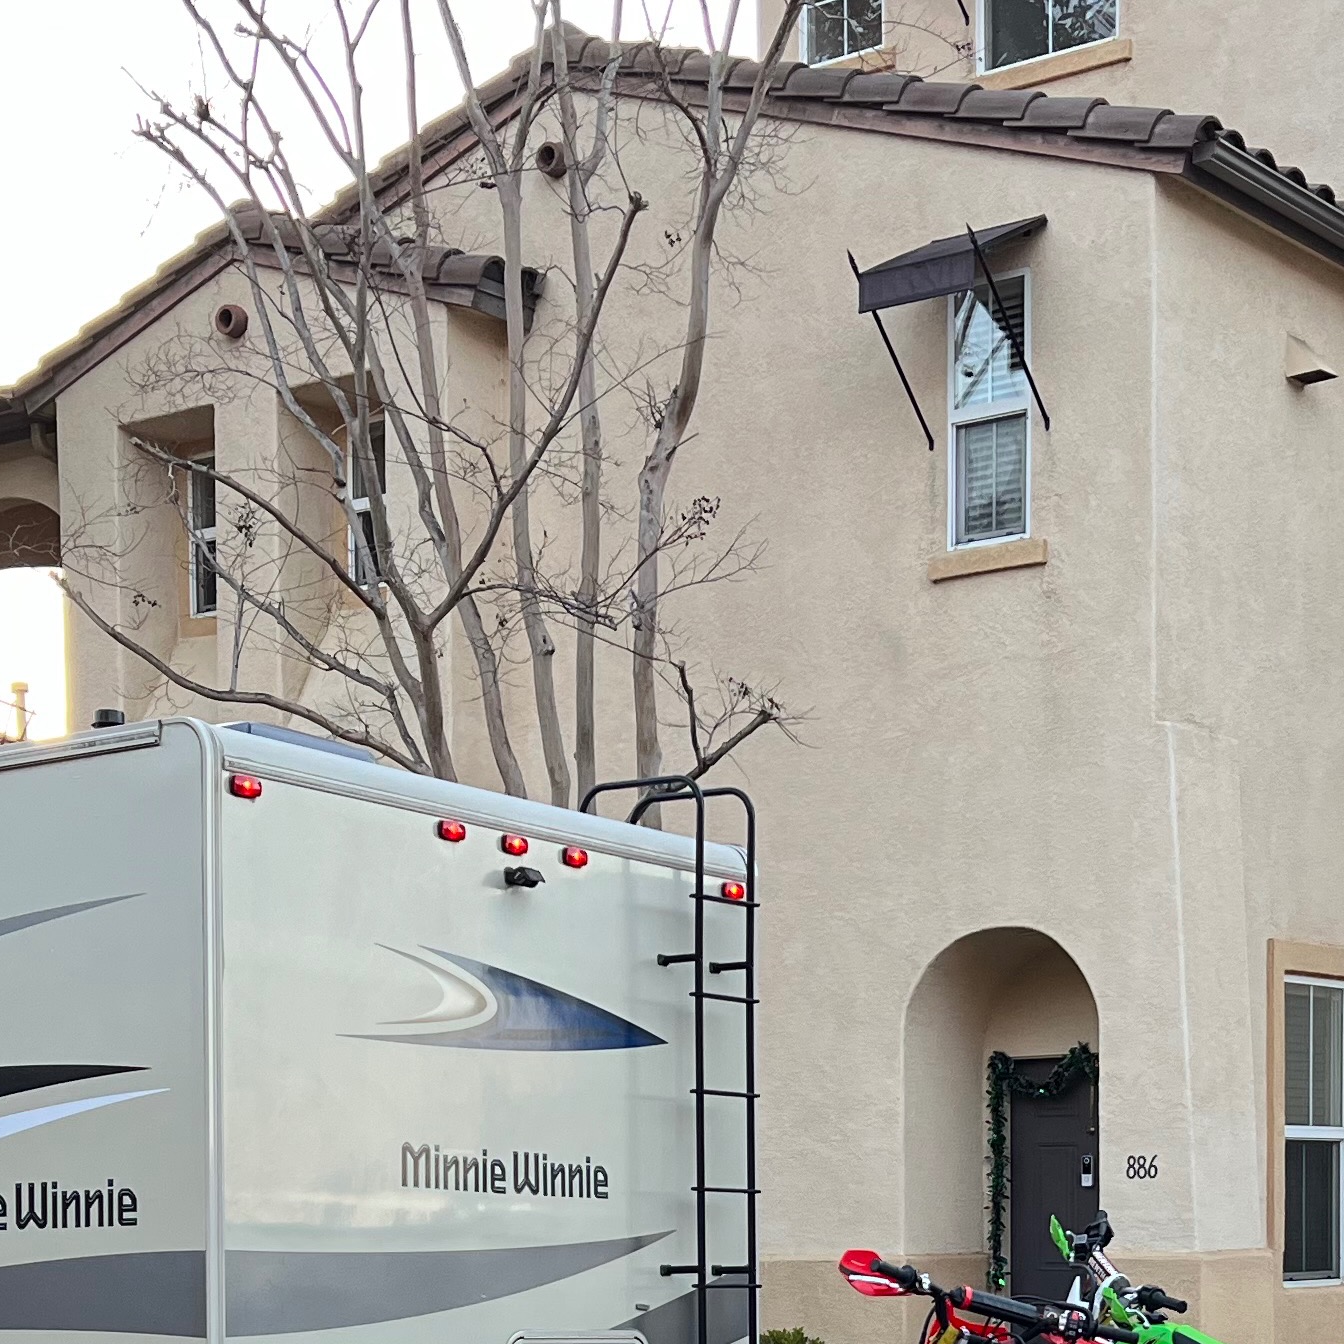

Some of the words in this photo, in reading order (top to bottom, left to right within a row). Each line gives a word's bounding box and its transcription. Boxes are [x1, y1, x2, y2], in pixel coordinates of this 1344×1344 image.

[401, 1141, 506, 1194] Minnie
[513, 1151, 609, 1200] Winnie
[1126, 1154, 1158, 1179] 886
[15, 1178, 138, 1230] Winnie
